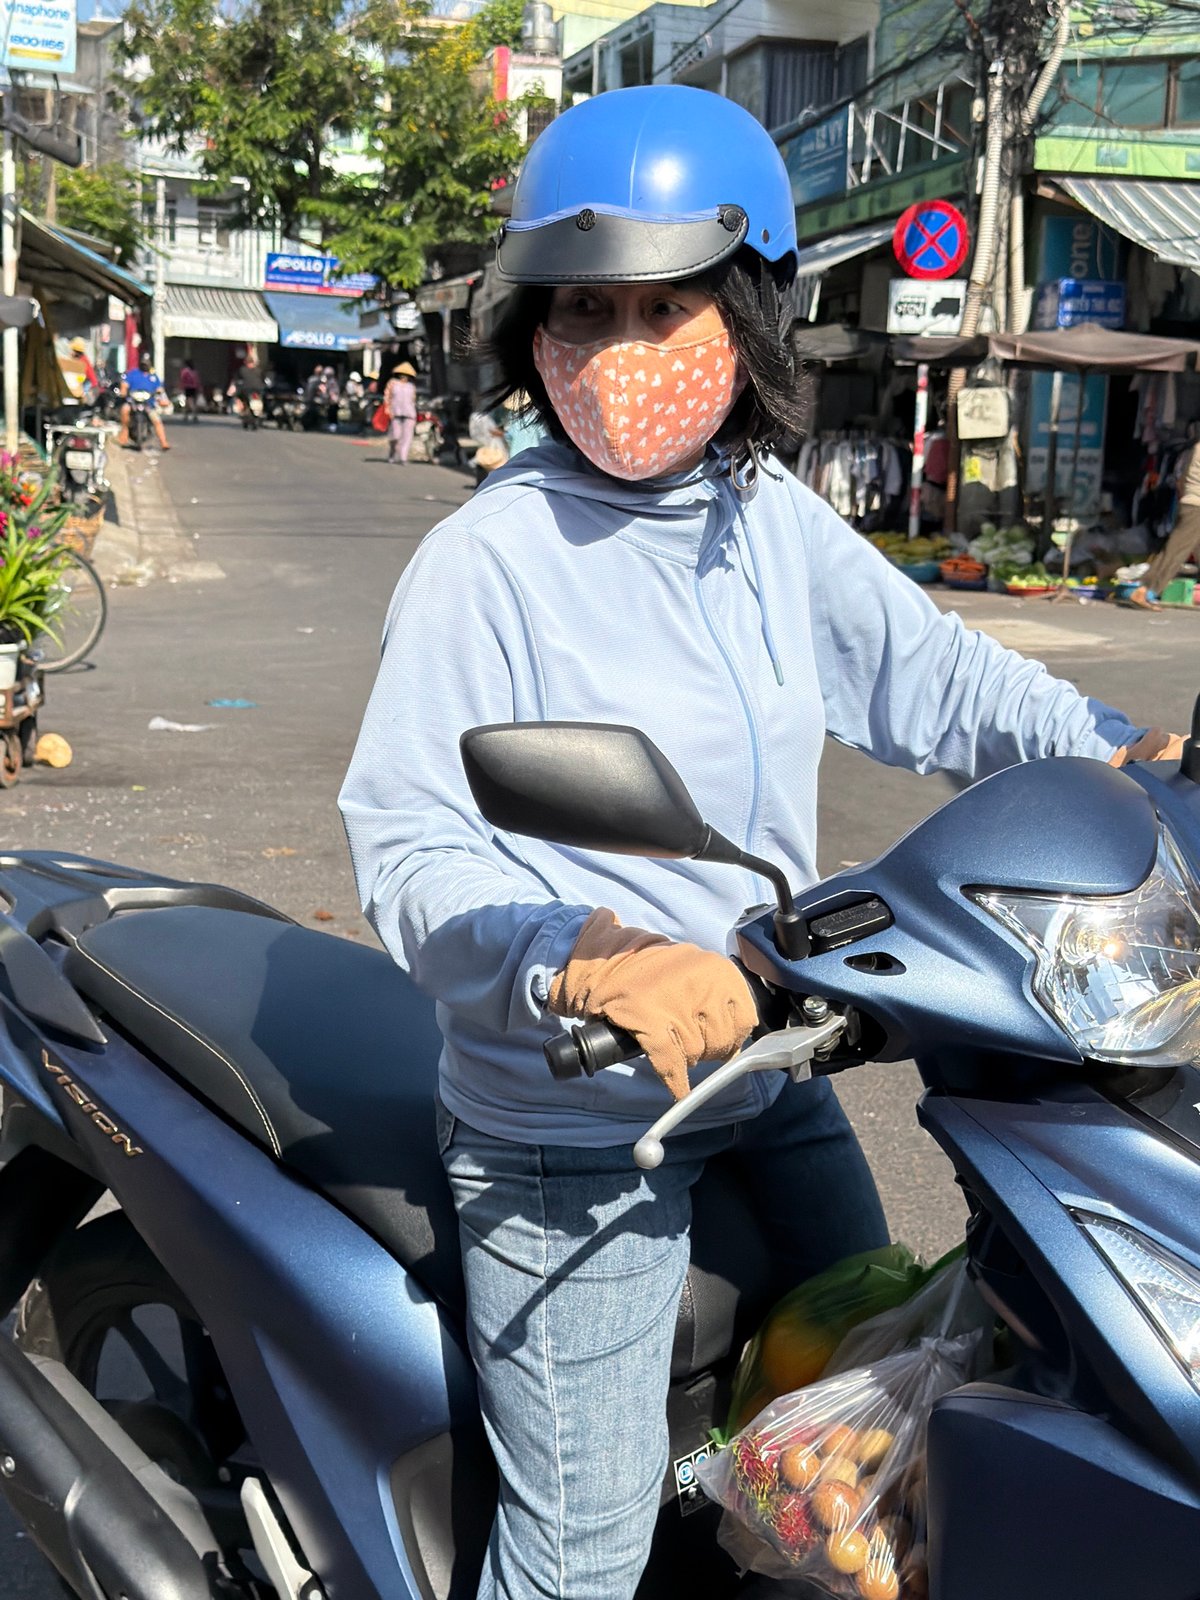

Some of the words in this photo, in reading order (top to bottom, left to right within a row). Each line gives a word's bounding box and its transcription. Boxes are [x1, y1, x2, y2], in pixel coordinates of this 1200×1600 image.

[270, 257, 323, 272] APOLLO
[286, 331, 335, 346] APOLLO
[41, 1048, 144, 1157] VISION
